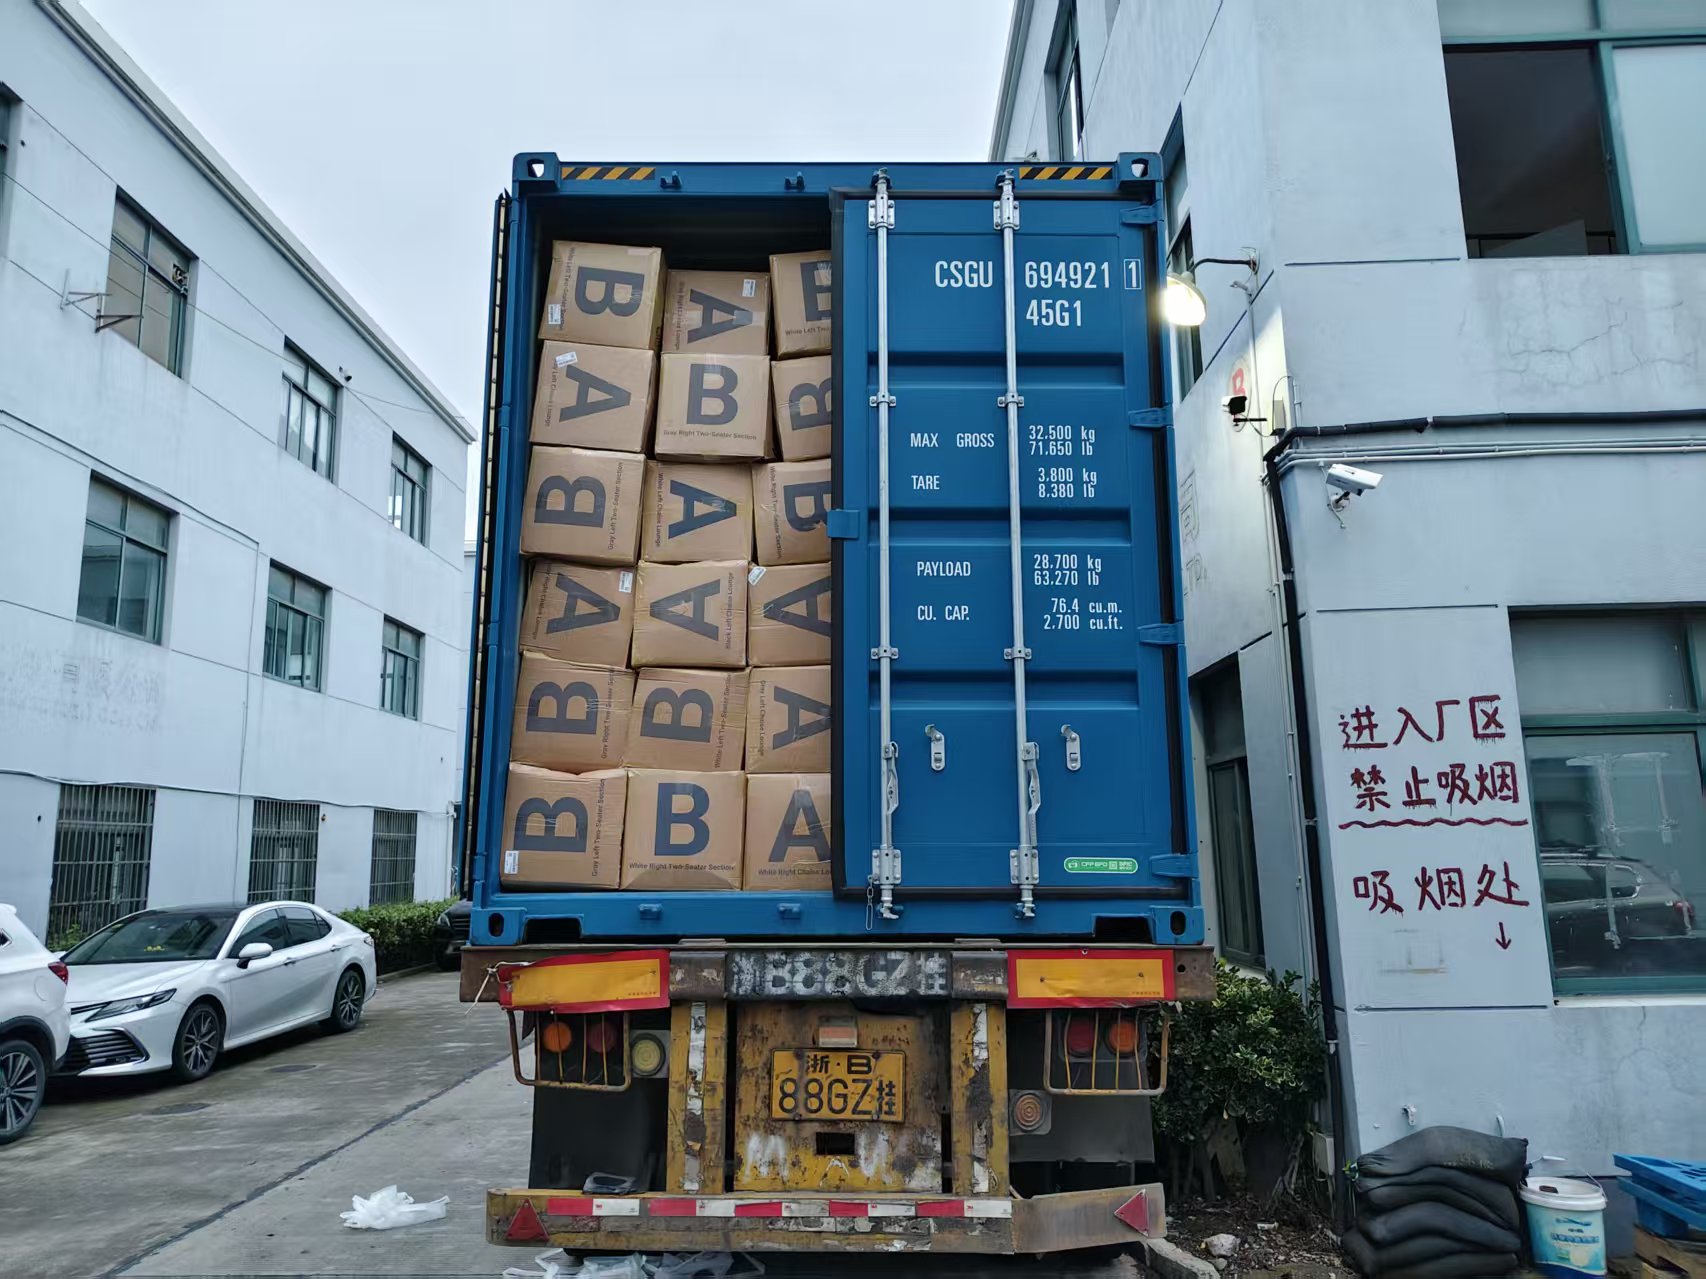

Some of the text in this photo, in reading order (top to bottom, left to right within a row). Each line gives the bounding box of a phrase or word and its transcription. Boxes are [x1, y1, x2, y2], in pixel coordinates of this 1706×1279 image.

[575, 266, 645, 317] B
[935, 260, 1138, 289] CSGU 694921 1
[687, 288, 753, 344] A
[1026, 299, 1082, 327] 45G1
[559, 364, 632, 423] A
[687, 363, 738, 425] B
[910, 432, 995, 448] MAX GROSS
[1081, 425, 1096, 443] kg
[1081, 441, 1093, 456] lb
[534, 475, 607, 528] B
[911, 475, 940, 490] TARE
[1083, 467, 1097, 485] kg
[1083, 483, 1095, 498] lb
[608, 522, 616, 535] Left
[668, 479, 737, 540] A
[916, 561, 971, 577] PAYLOAD
[1087, 554, 1102, 573] kg
[1087, 570, 1100, 585] lb
[546, 572, 621, 634] A
[649, 579, 721, 641] A
[763, 575, 832, 638] A
[917, 605, 970, 620] CU. CAP.
[1051, 598, 1122, 613] 76.4 cu.m.
[1089, 615, 1123, 630] cu.ft.
[526, 681, 598, 735] B
[640, 687, 714, 743] B
[772, 685, 832, 750] A
[1338, 695, 1506, 750] 进入厂区
[1350, 761, 1520, 812] 禁止吸烟
[513, 796, 589, 853] B
[654, 782, 710, 856] B
[768, 789, 832, 863] A
[592, 846, 600, 860] Left
[1353, 861, 1530, 915] 吸烟处
[779, 1077, 896, 1116] 88GZ挂
